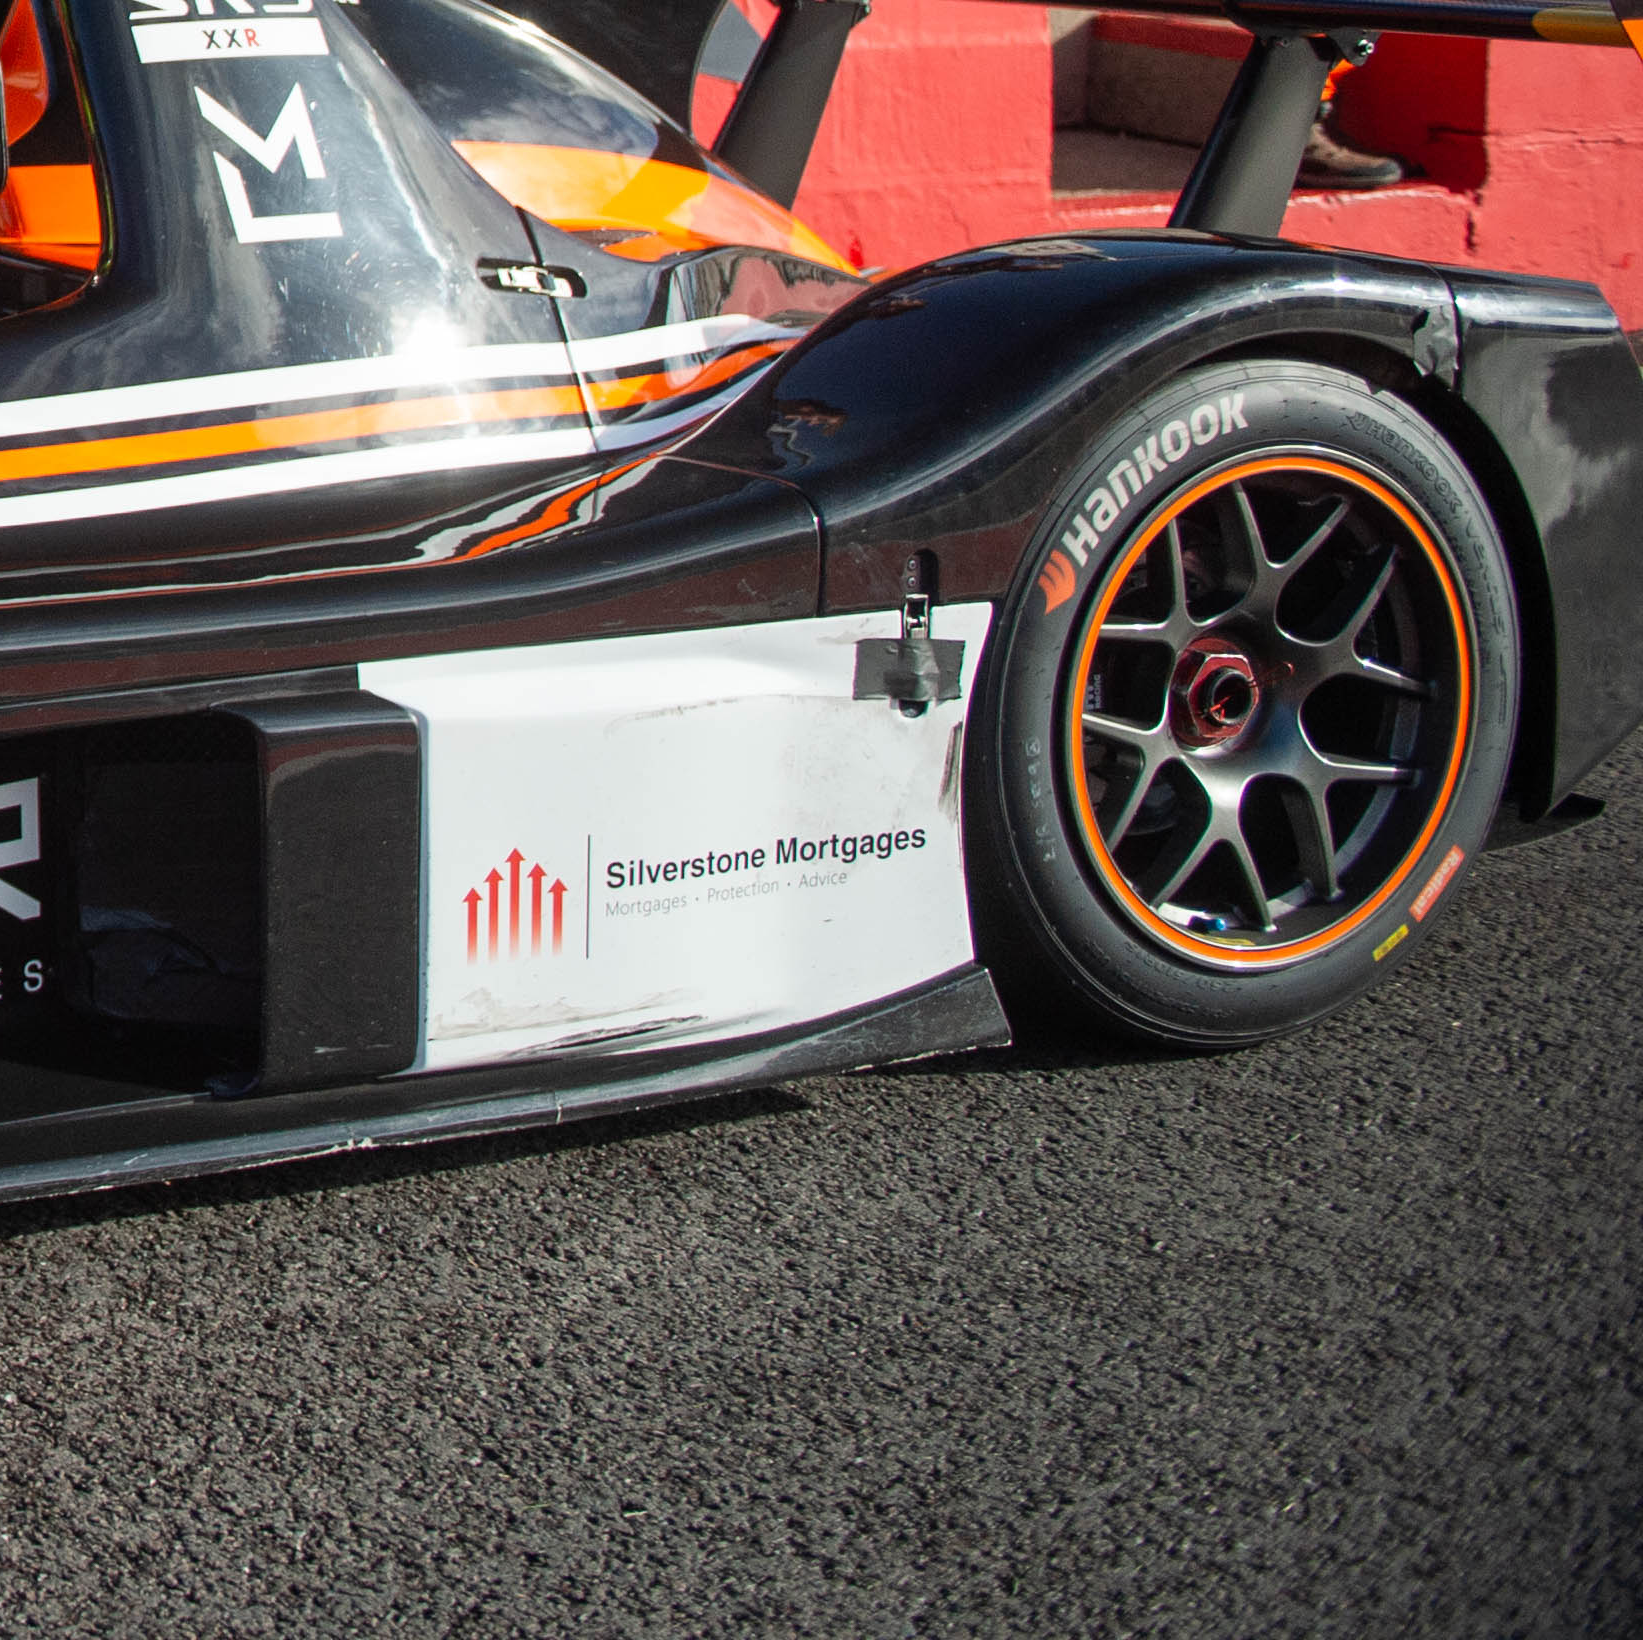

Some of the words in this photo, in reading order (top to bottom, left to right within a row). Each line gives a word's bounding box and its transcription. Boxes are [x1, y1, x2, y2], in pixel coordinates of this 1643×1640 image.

[203, 28, 260, 50] XXR
[604, 844, 767, 890] Silverstone
[774, 826, 928, 867] Mortgages
[604, 891, 689, 919] Mortgages
[706, 876, 781, 904] Protection
[798, 868, 849, 890] Advice
